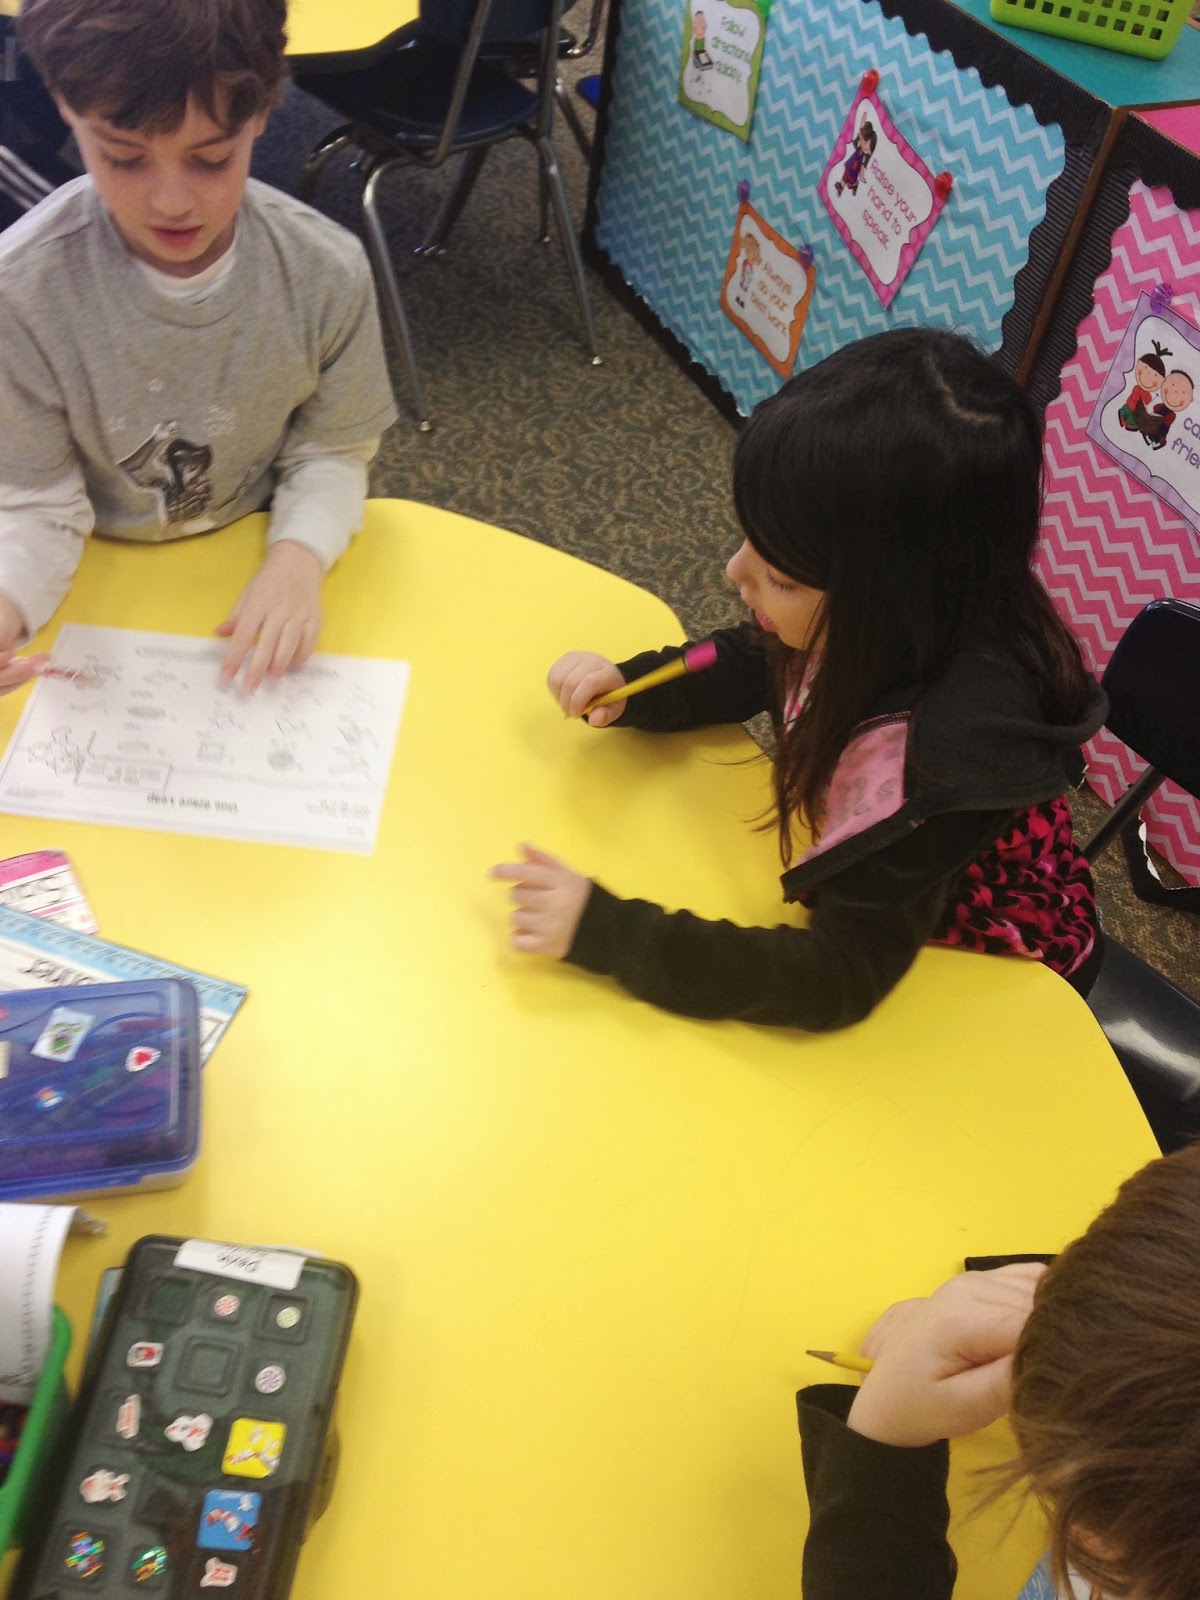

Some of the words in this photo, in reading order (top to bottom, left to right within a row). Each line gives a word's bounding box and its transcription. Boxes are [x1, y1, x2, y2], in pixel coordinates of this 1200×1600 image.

[867, 185, 893, 222] hand
[892, 217, 901, 236] to
[870, 157, 895, 196] Raise
[894, 191, 917, 223] your
[862, 209, 889, 250] speak
